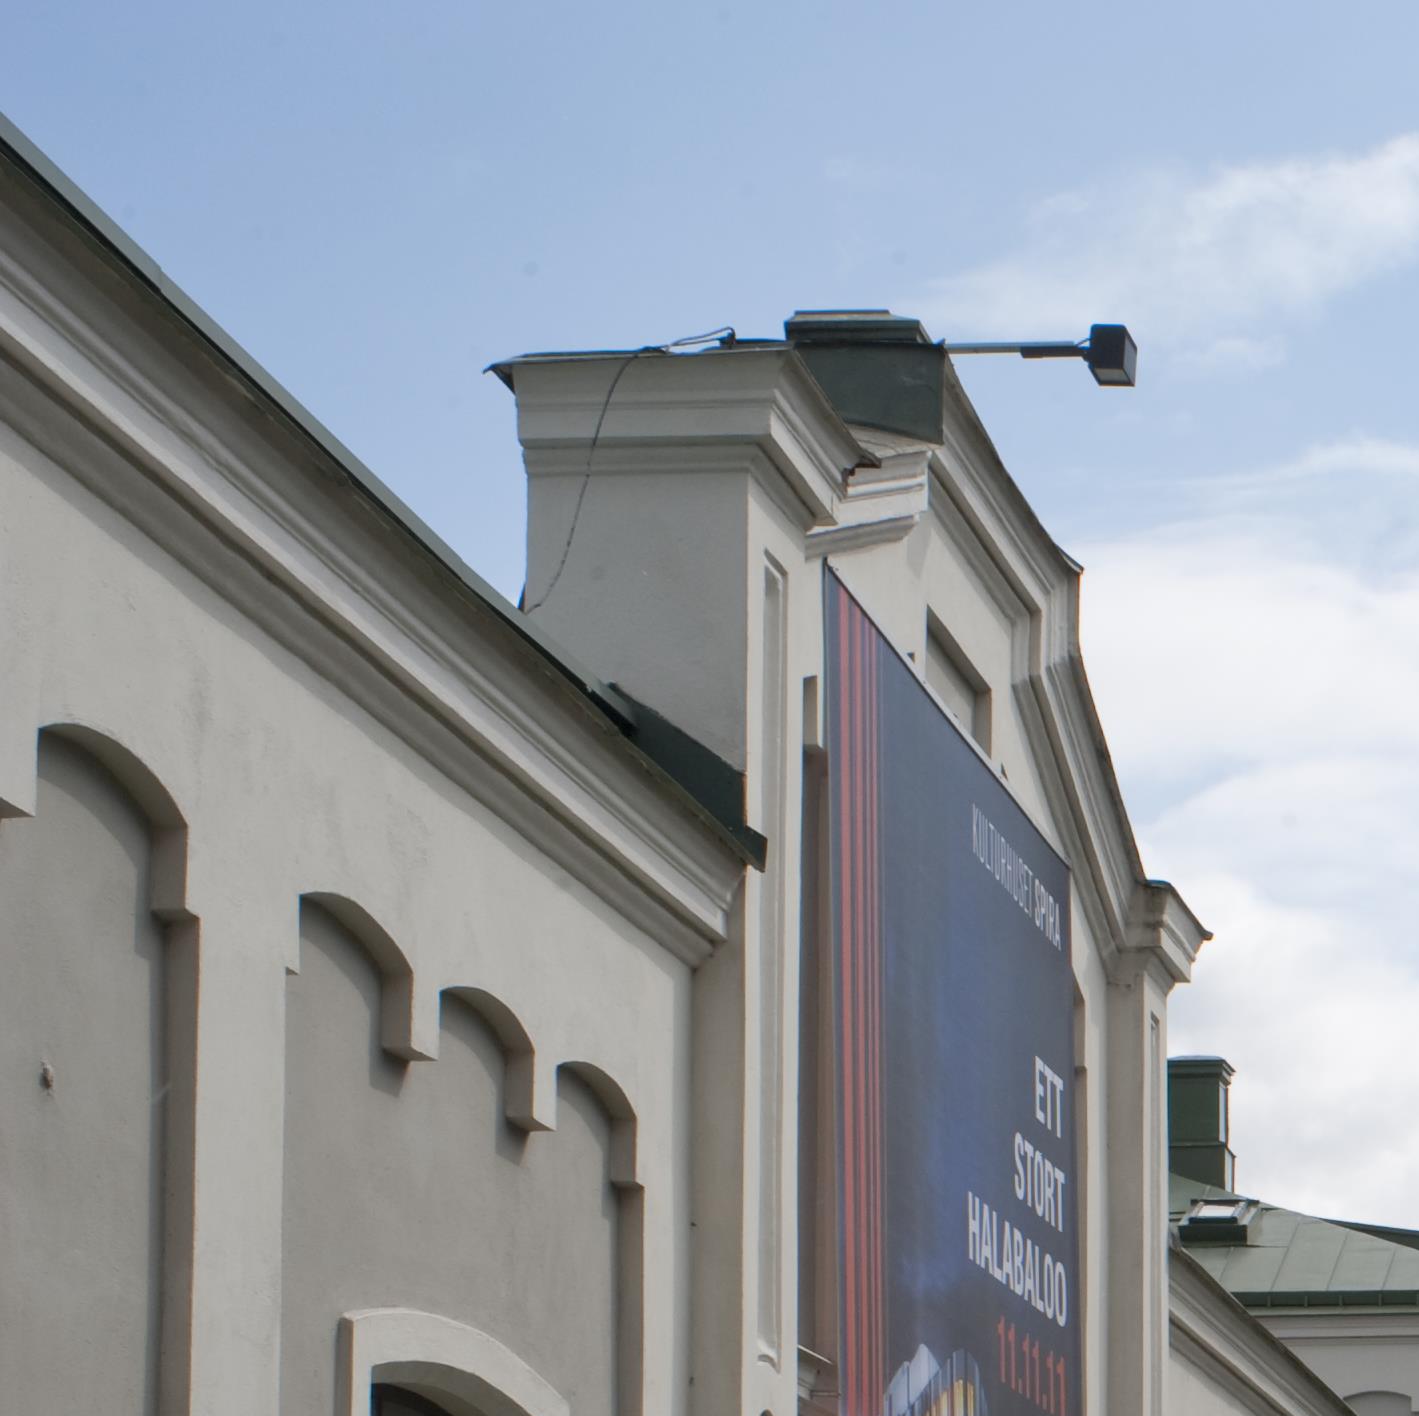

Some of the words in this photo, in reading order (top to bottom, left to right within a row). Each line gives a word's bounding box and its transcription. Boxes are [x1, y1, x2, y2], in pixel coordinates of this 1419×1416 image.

[972, 802, 1034, 919] KULTURHUSET
[1034, 877, 1062, 951] SPIRA
[1034, 1054, 1064, 1139] ETT
[1013, 1130, 1066, 1233] STORT
[967, 1190, 1068, 1328] HALABALOO
